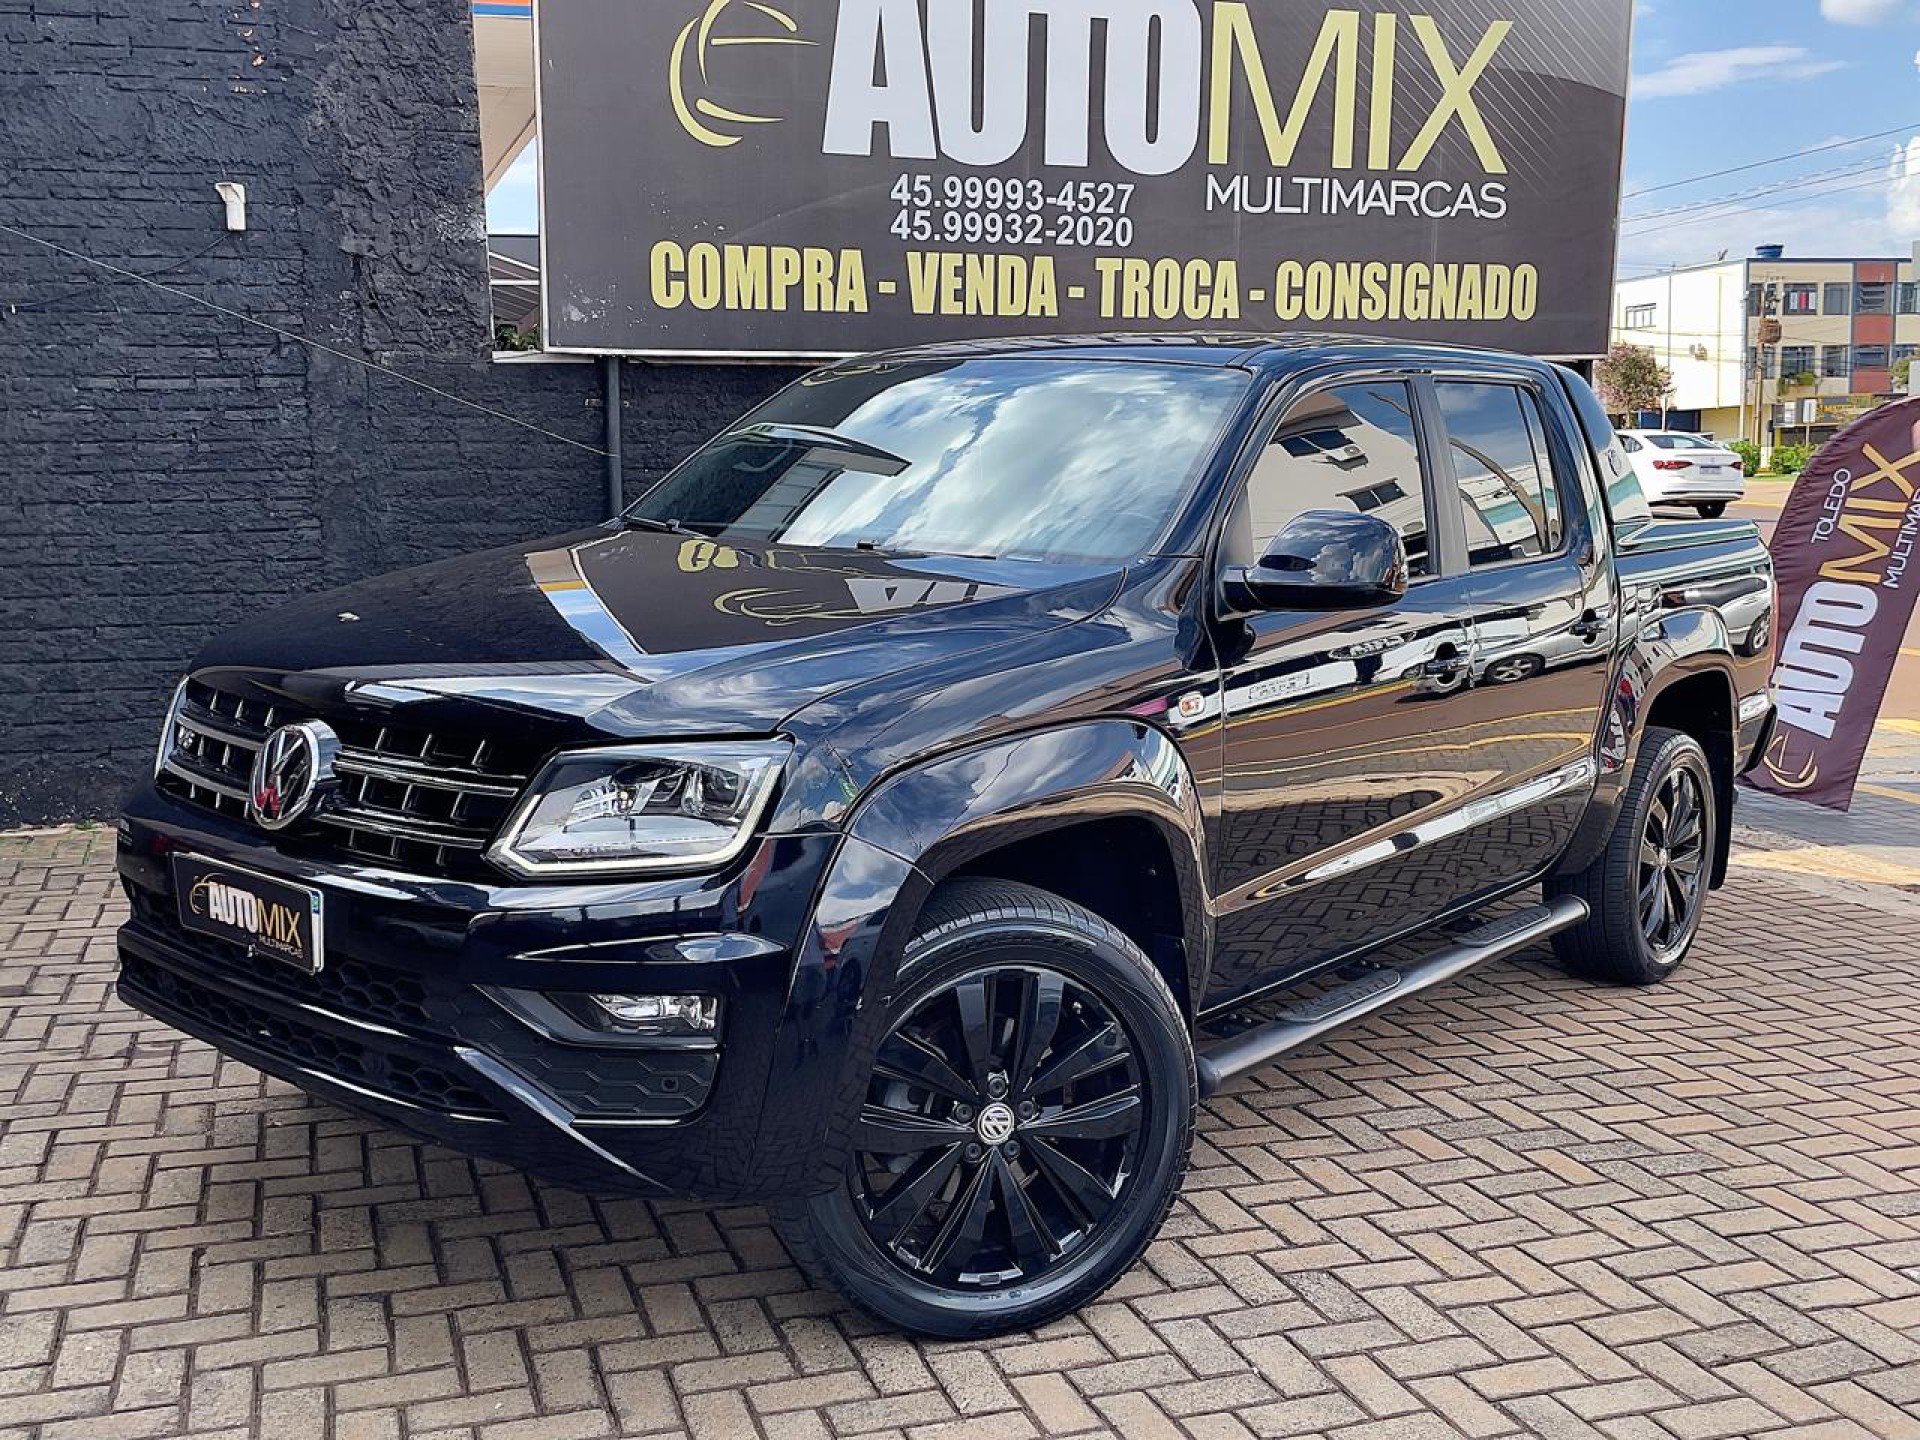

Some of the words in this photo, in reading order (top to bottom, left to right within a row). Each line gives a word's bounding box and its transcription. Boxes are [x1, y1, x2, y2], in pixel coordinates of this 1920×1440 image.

[891, 173, 1134, 213] 45.99993-4527
[1206, 174, 1507, 218] MULTIMARCAS
[891, 211, 1133, 246] 45.99932-2020
[650, 241, 868, 313] COMPRA
[906, 251, 1058, 317] VENDA
[1096, 257, 1239, 319] TROCA
[1275, 260, 1537, 321] CONSIGNADO
[1812, 468, 1850, 543] TOLEDO
[208, 881, 302, 948] AUTOMIX
